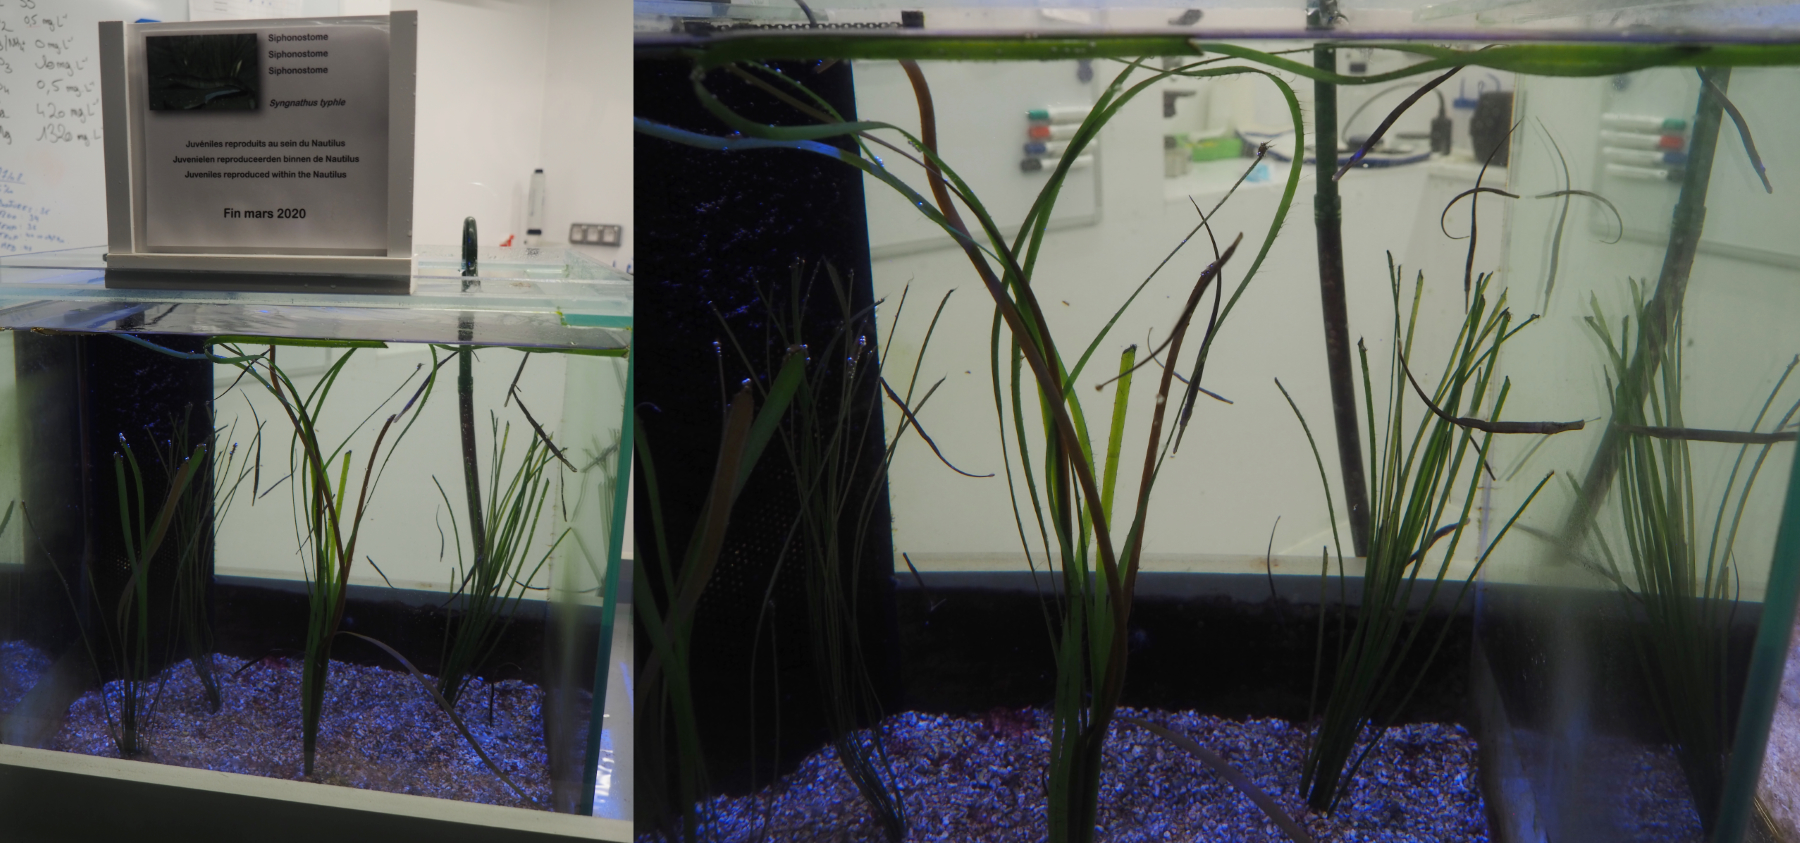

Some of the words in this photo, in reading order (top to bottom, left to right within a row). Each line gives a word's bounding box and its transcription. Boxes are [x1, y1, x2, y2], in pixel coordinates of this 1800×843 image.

[268, 33, 329, 43] Siphonostome
[268, 49, 329, 59] Siphonostome
[268, 66, 329, 76] Siphonostome
[269, 98, 318, 108] Syngnathus
[185, 139, 223, 149] Juvéniles
[224, 138, 267, 149] reproduits
[268, 140, 279, 148] au
[280, 138, 298, 148] sein
[299, 138, 310, 148] du
[311, 138, 346, 148] Nautilus
[172, 154, 215, 164] Juvenielen
[216, 154, 282, 164] reproduceerden
[283, 154, 311, 163] binnen
[313, 154, 324, 163] de
[325, 154, 360, 163] Nautilus
[184, 170, 222, 180] Juveniles
[223, 170, 270, 180] reproduced
[271, 170, 297, 179] within
[298, 170, 311, 179] the
[312, 170, 347, 179] Nautilus
[223, 208, 241, 219] Fin
[243, 210, 275, 219] mars
[277, 208, 307, 219] 2020
